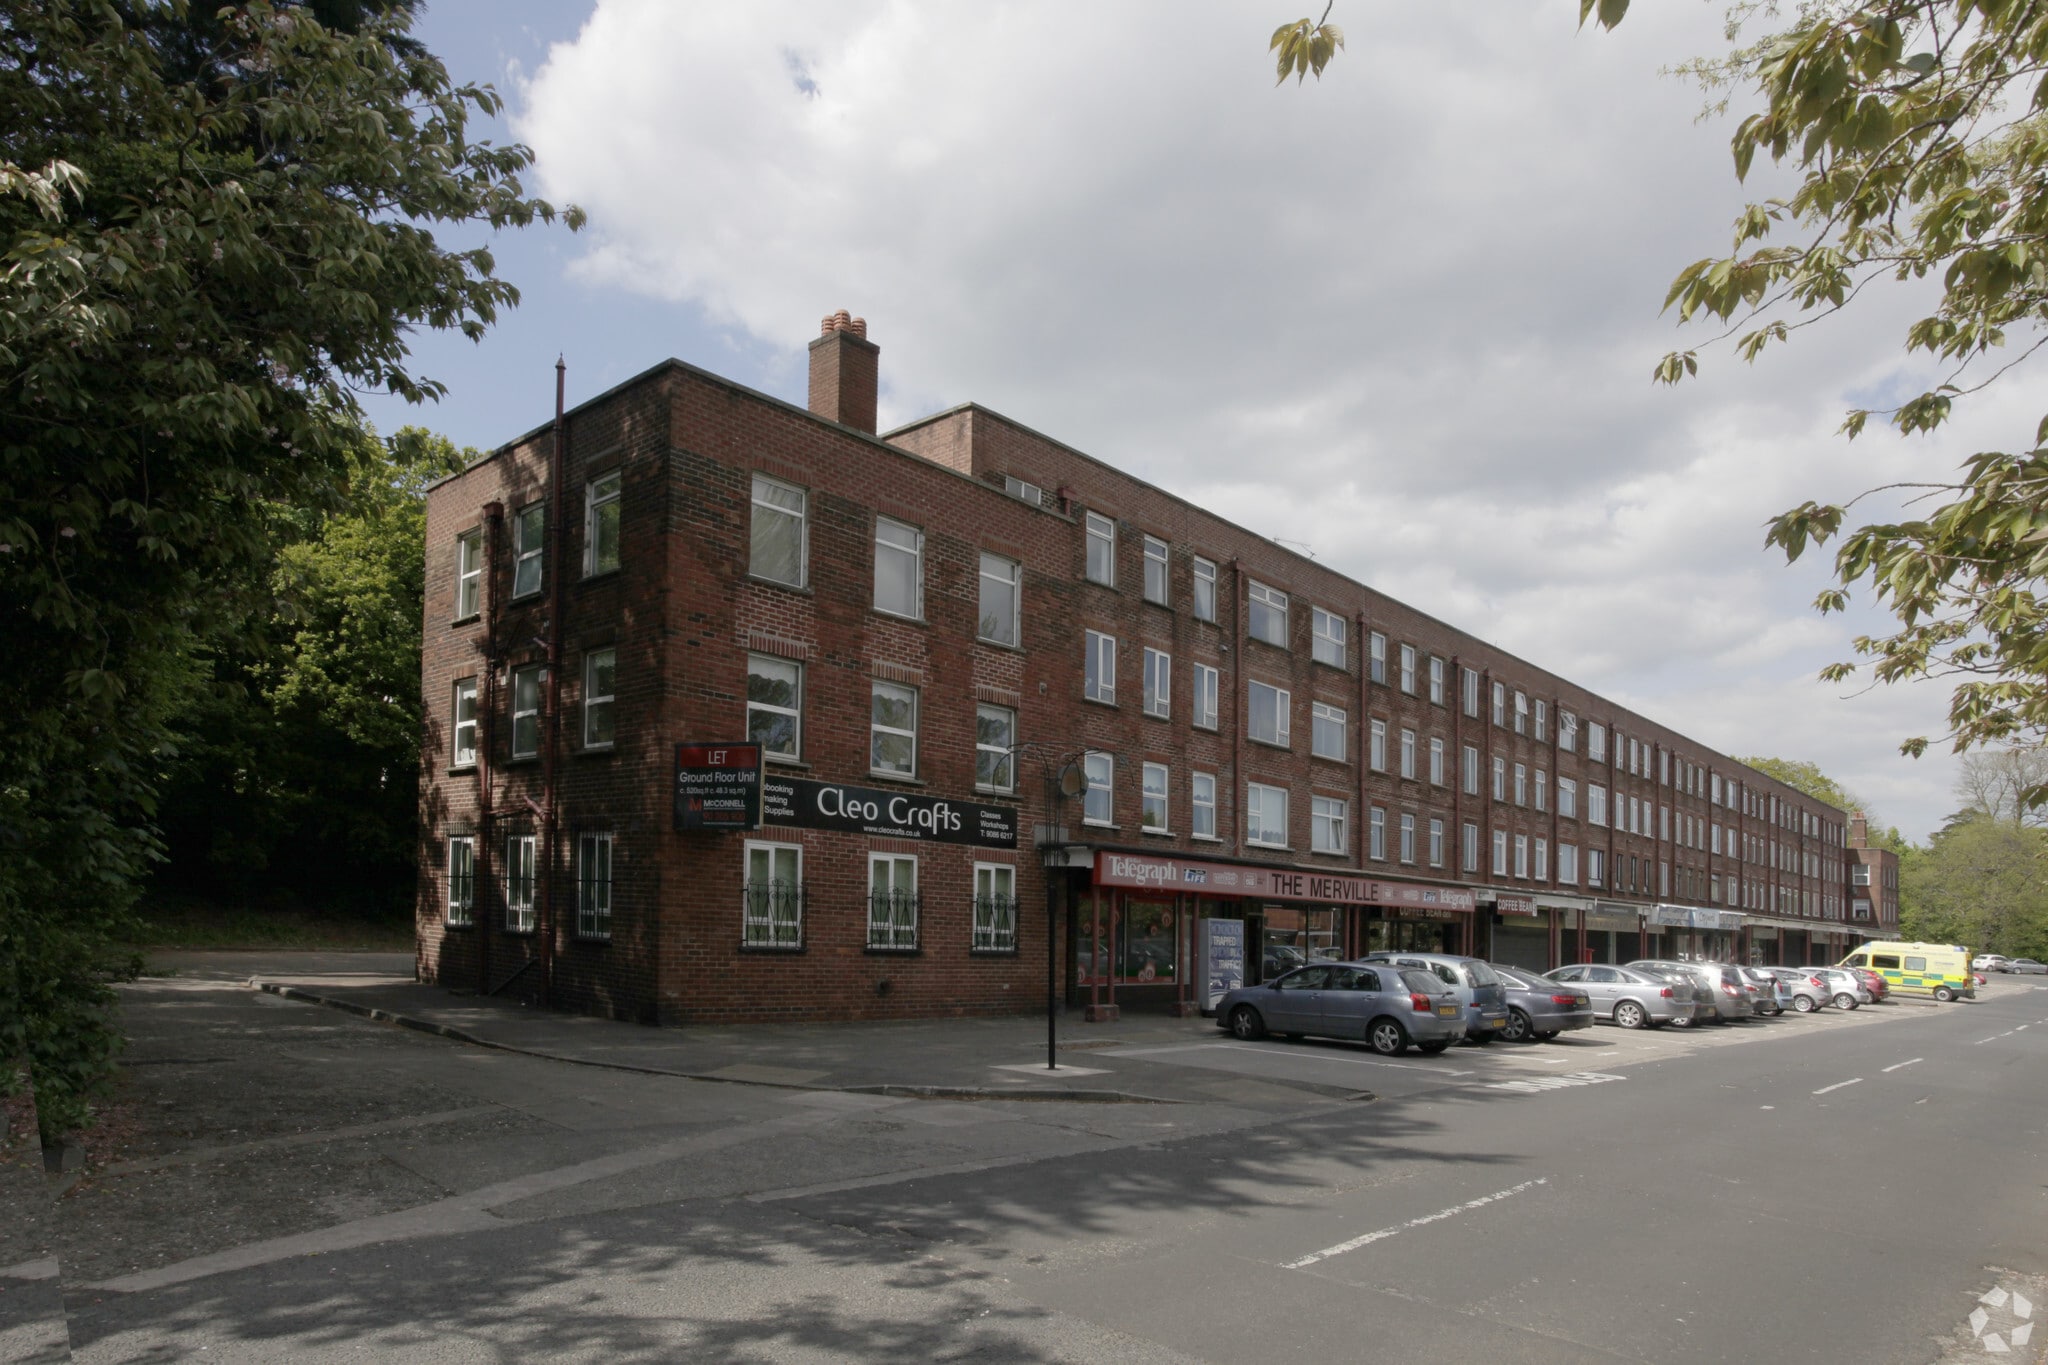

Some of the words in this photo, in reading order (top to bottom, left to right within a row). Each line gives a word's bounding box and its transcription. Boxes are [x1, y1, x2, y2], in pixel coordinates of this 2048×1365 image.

[708, 750, 727, 764] LET
[680, 771, 713, 783] Ground
[714, 771, 736, 783] Floor
[738, 771, 756, 783] Unit
[764, 805, 795, 817] Supplies
[817, 787, 879, 821] Cleo
[888, 797, 962, 835] Crafts
[980, 810, 1001, 819] Classes
[863, 825, 922, 838] www.cleocrafts.co.uk
[980, 820, 1009, 830] Workshops
[1109, 855, 1177, 886] Telegraph
[1272, 873, 1303, 896] THE
[1310, 877, 1380, 902] MERVILLE
[1439, 888, 1473, 909] Telegraph
[1498, 899, 1518, 912] COFFEE
[1519, 899, 1533, 913] BEAN
